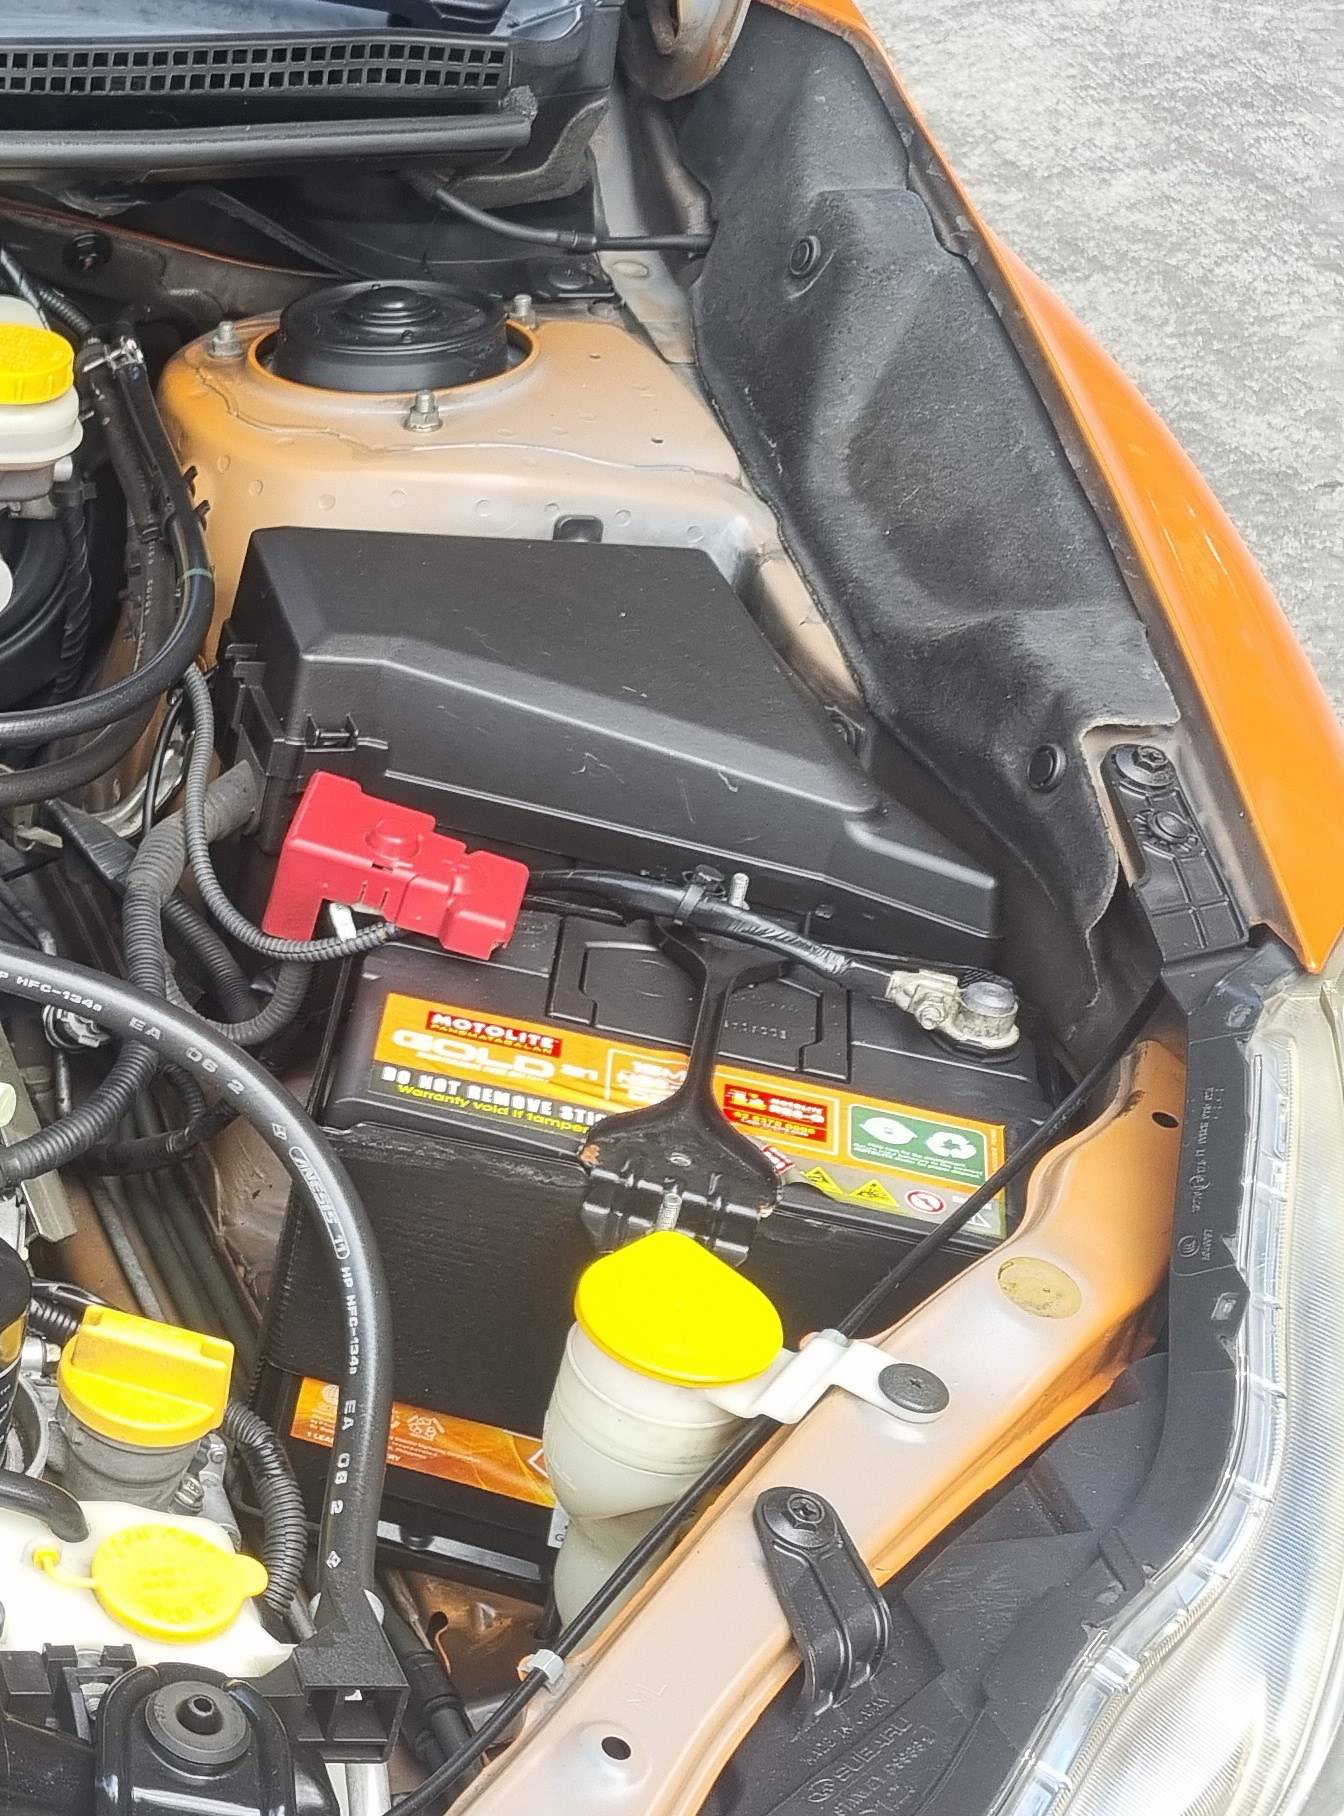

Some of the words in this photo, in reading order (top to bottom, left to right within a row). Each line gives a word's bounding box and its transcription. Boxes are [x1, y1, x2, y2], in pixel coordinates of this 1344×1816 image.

[431, 1011, 556, 1050] MOTOLITE
[128, 1016, 163, 1041] EA
[226, 1078, 245, 1096] 2
[391, 1029, 555, 1078] GOLD
[382, 1066, 411, 1085] DO
[419, 1074, 461, 1098] NOT
[467, 1085, 554, 1115] REMOVE
[397, 1083, 470, 1109] Warranty
[473, 1097, 509, 1117] void
[512, 1107, 523, 1121] if
[341, 1267, 354, 1288] HP
[341, 1399, 357, 1431] EA
[330, 1499, 344, 1514] 2
